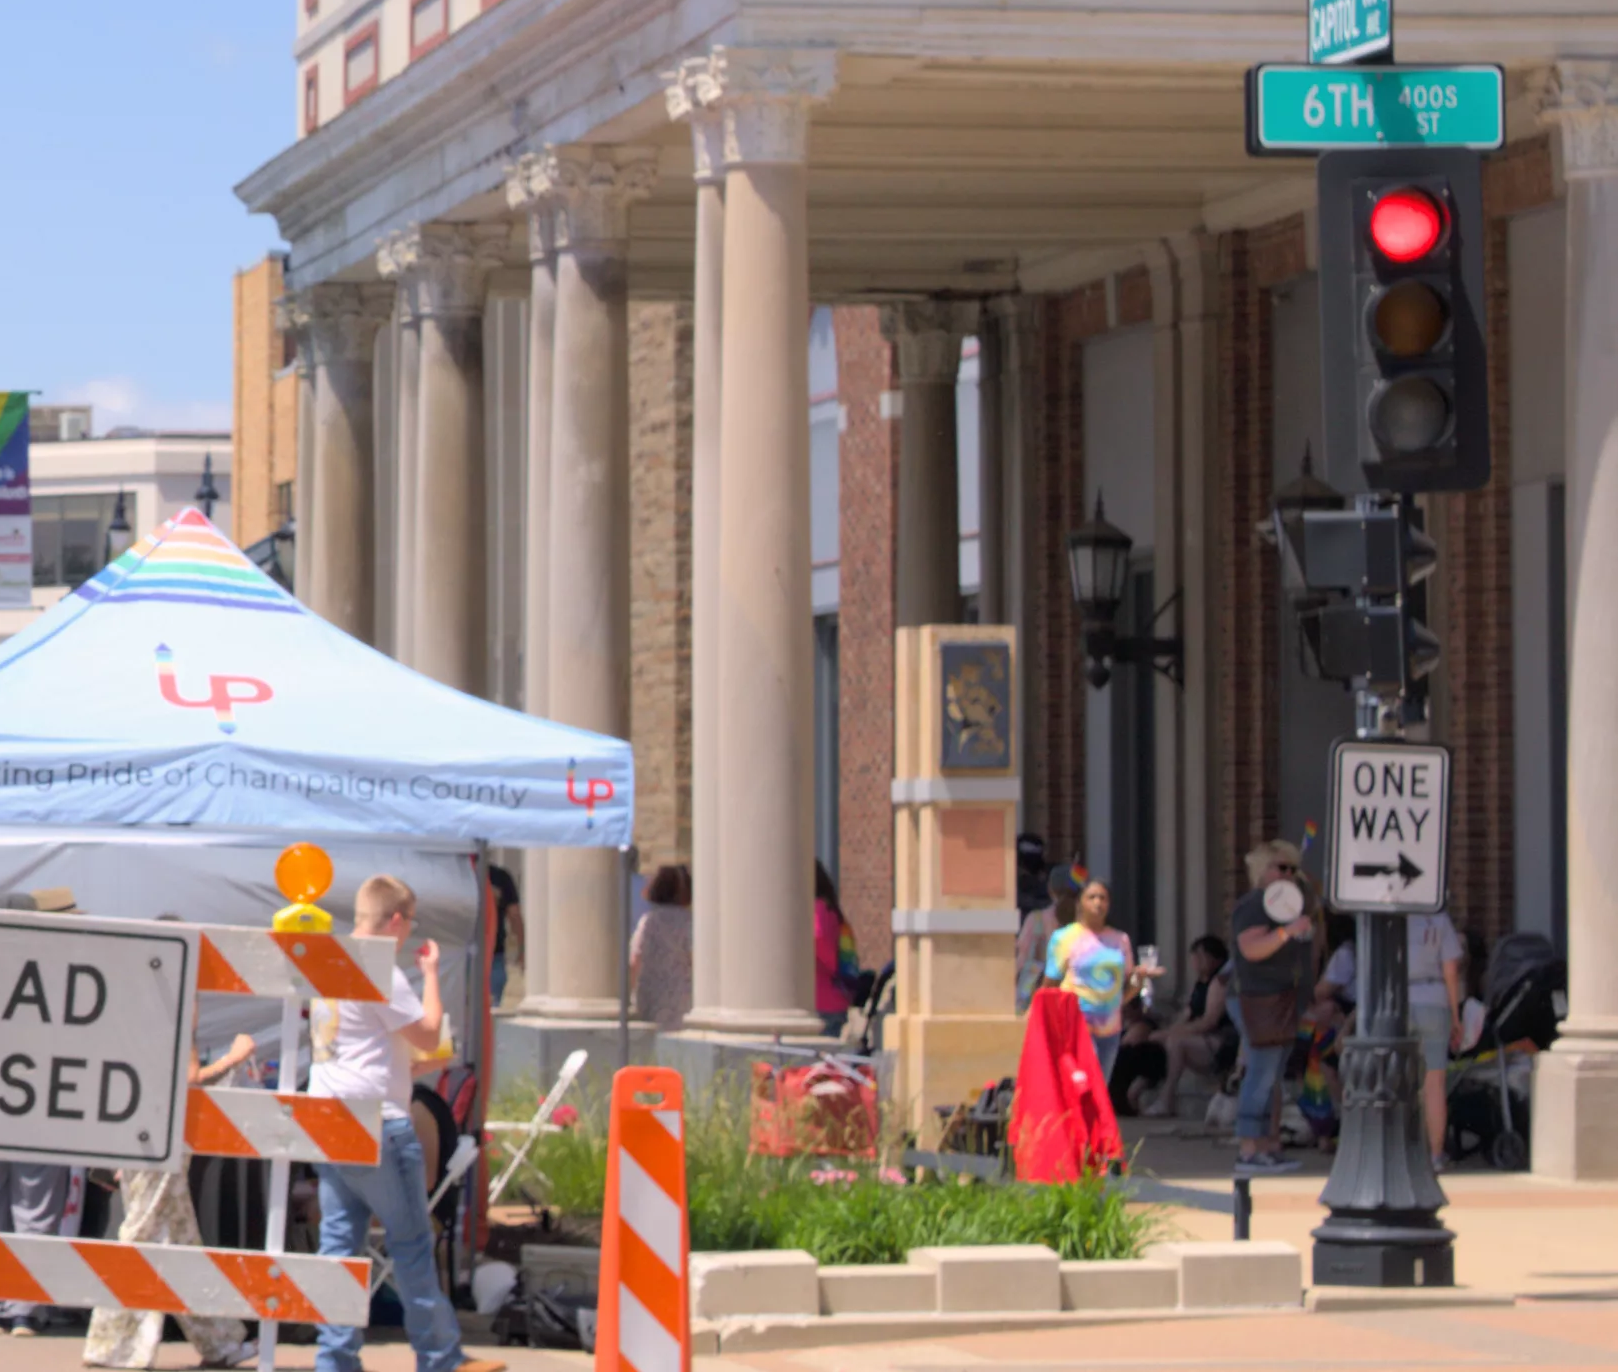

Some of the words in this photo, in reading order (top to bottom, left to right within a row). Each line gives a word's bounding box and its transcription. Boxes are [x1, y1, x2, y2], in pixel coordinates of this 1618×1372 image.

[1366, 9, 1381, 37] AVE
[1303, 84, 1374, 128] 6TH
[1417, 112, 1441, 136] ST
[66, 761, 154, 786] Pride
[164, 760, 197, 786] of
[204, 761, 397, 801] Champaign
[409, 773, 530, 809] County
[1353, 761, 1429, 799] ONE
[1350, 805, 1430, 842] WAY
